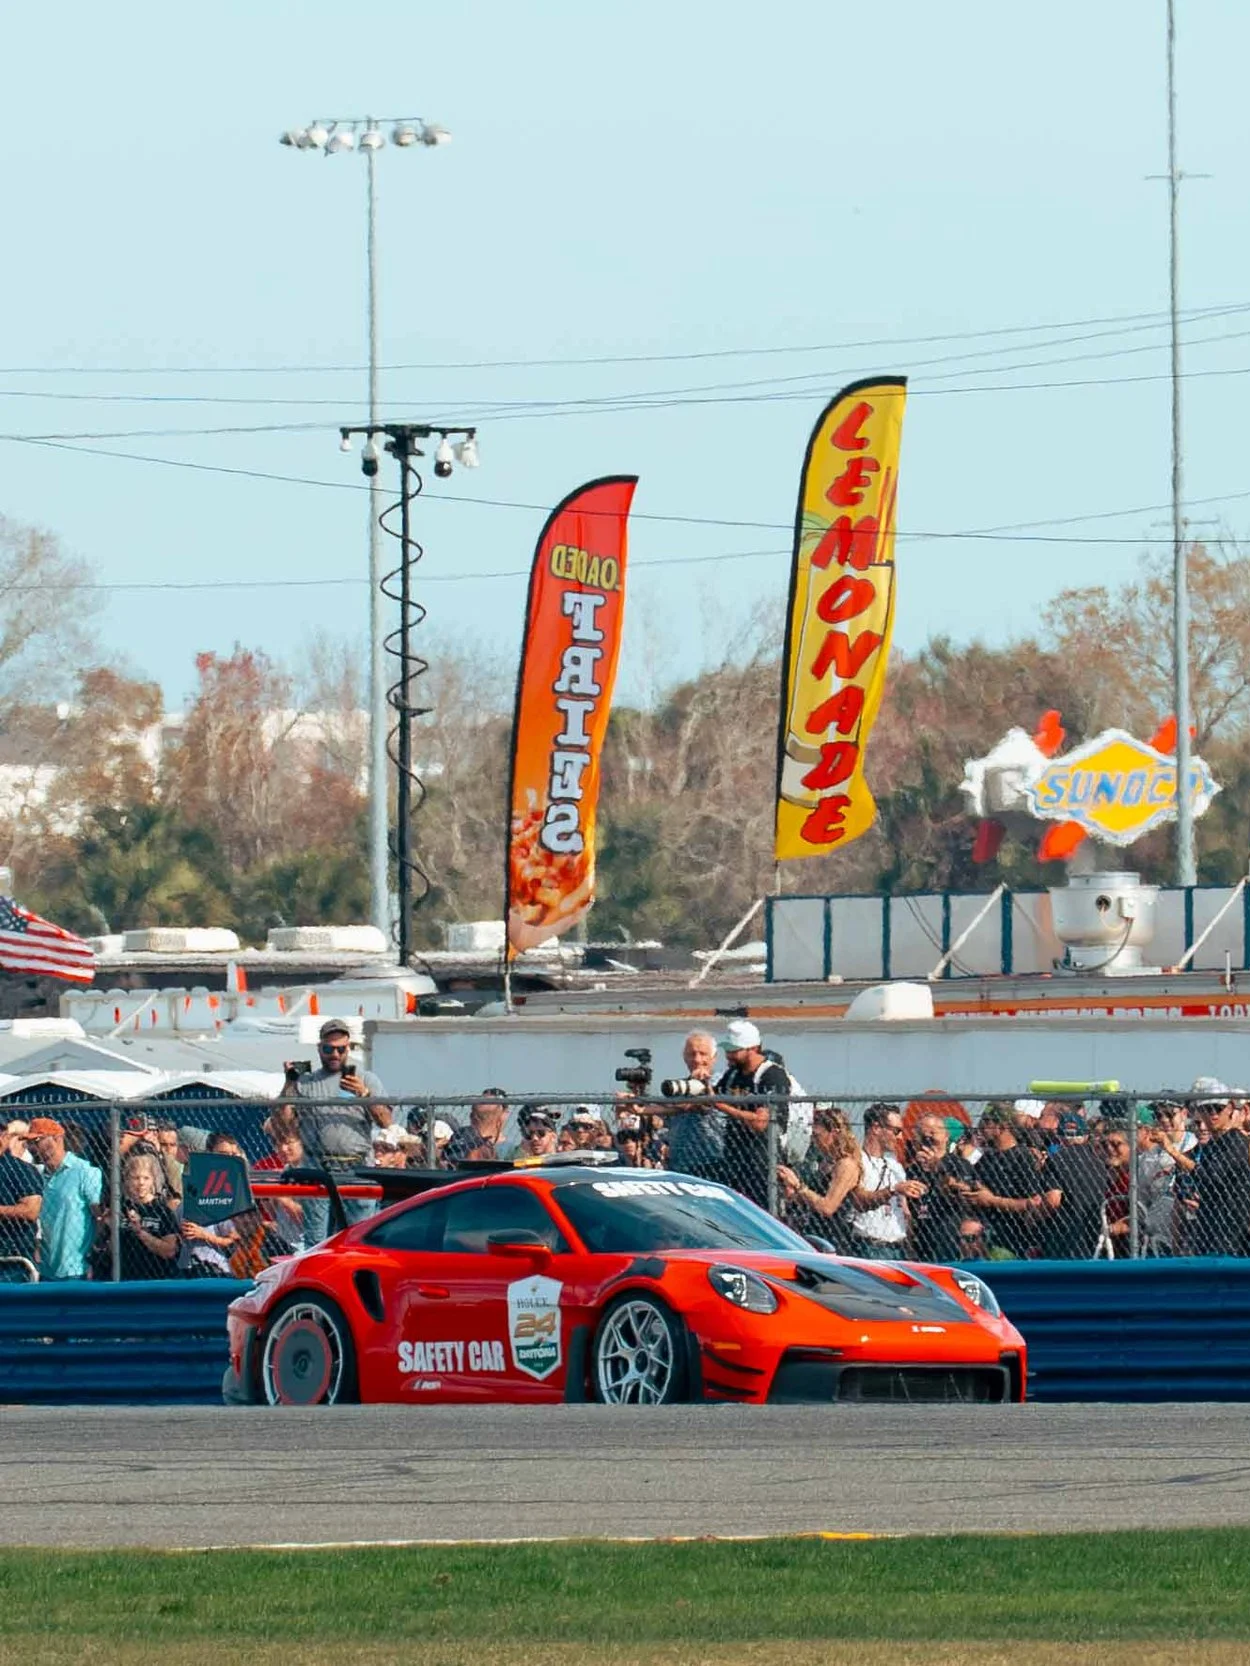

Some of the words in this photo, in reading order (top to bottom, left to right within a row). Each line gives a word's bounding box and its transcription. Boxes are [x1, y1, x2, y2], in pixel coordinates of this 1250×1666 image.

[797, 401, 885, 846] LEMONADE
[198, 1197, 233, 1206] MANTHEY
[514, 1311, 556, 1339] 24
[397, 1340, 465, 1374] SAFETY
[468, 1340, 507, 1373] CAR
